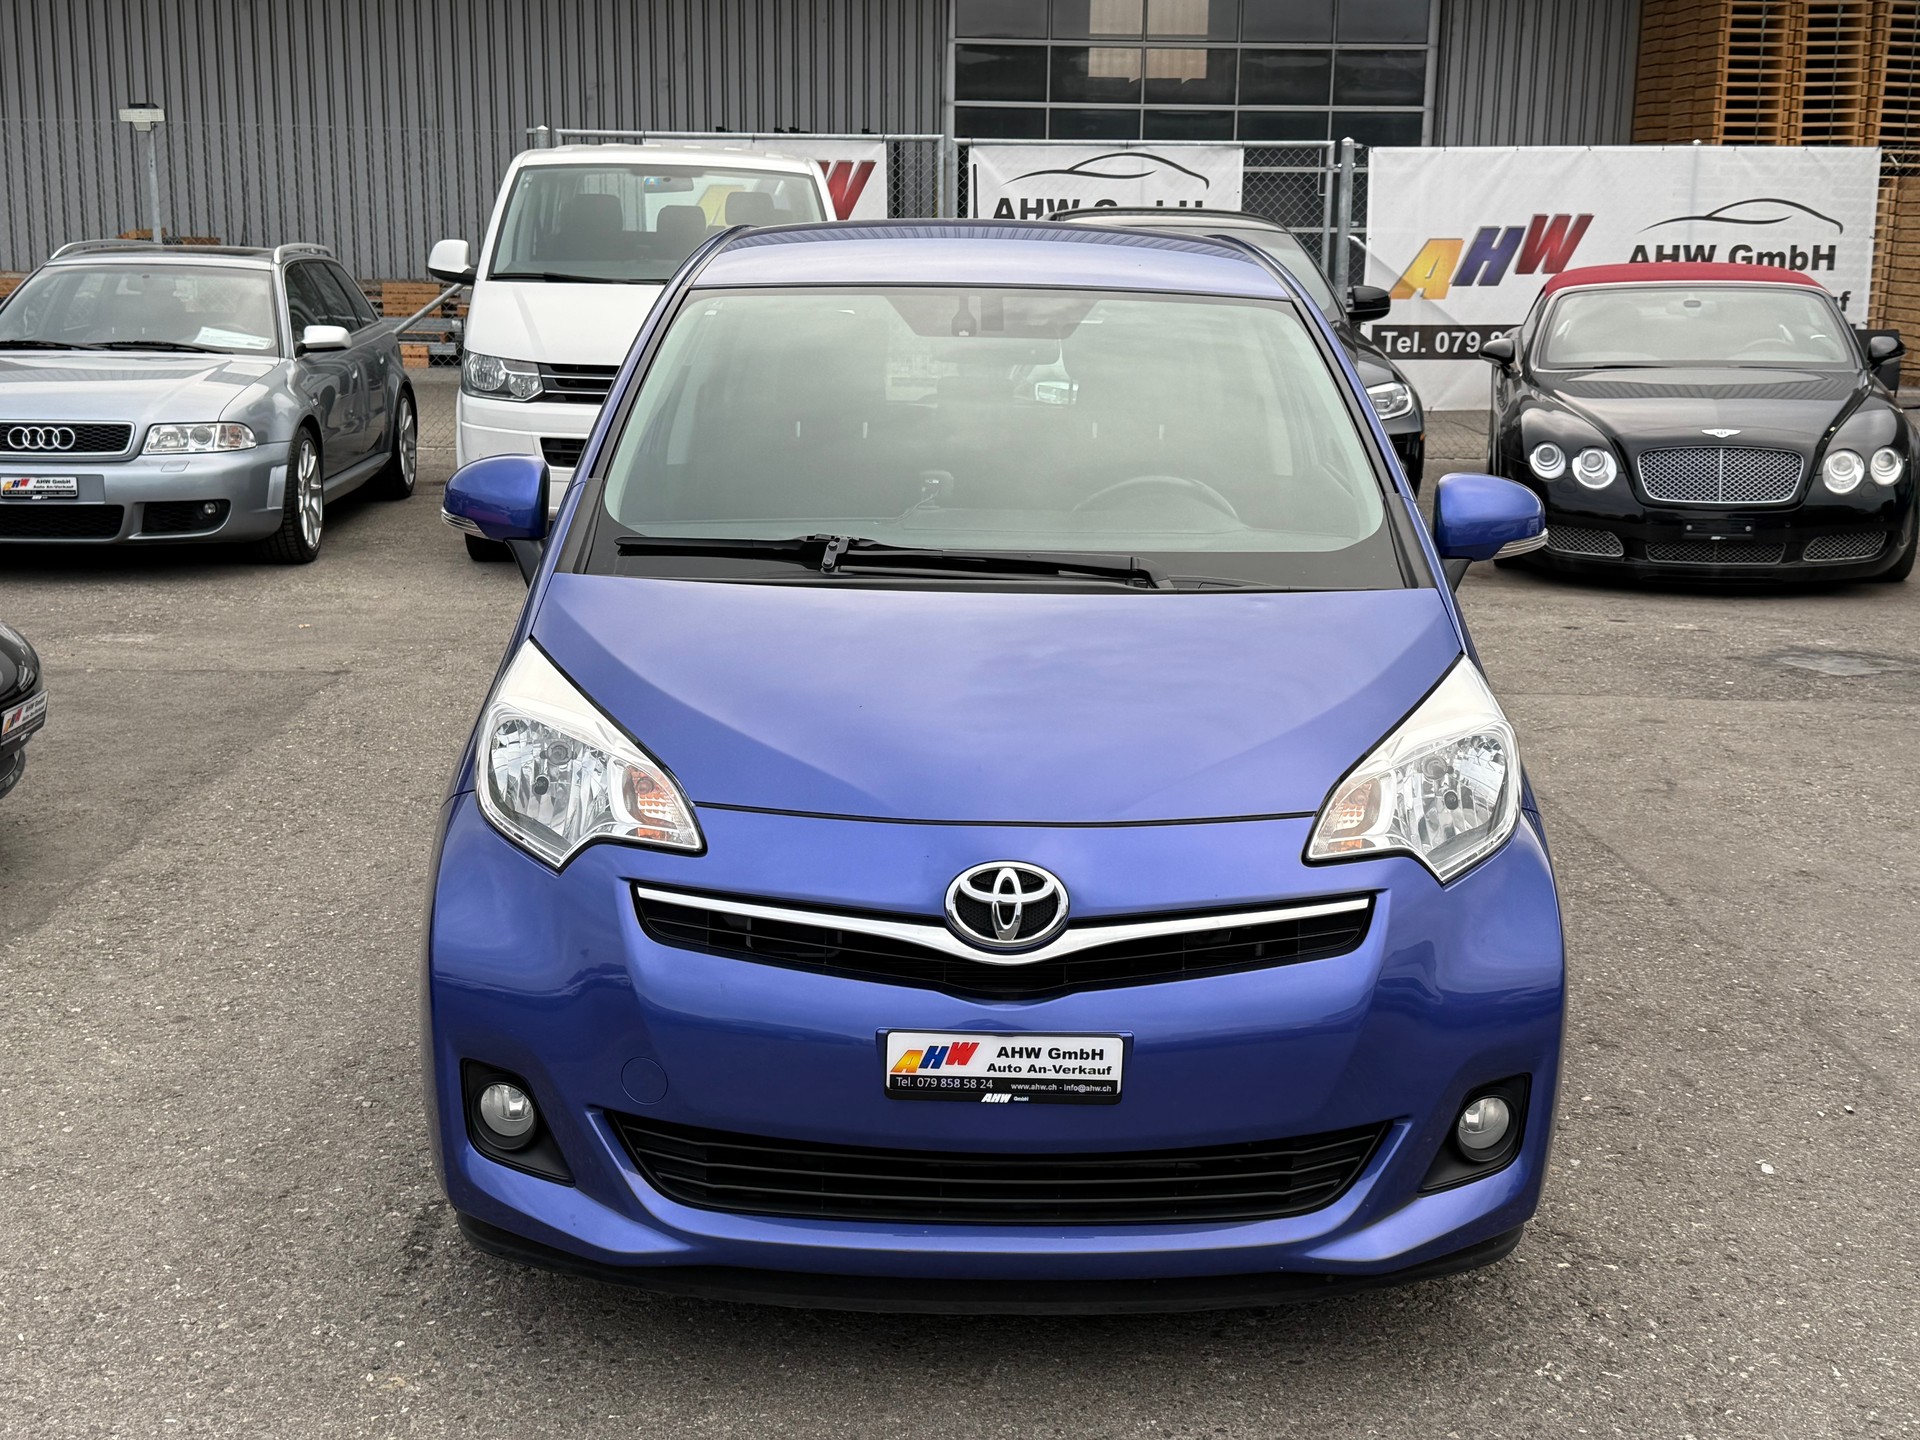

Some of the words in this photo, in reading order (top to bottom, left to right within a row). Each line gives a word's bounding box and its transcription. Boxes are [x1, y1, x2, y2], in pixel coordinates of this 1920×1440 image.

[1389, 213, 1594, 299] AHW
[1728, 244, 1837, 271] GmbH
[1380, 331, 1427, 353] Tel.
[1434, 331, 1481, 353] 079
[890, 1042, 979, 1073] AHW
[996, 1046, 1042, 1059] AHW
[1047, 1047, 1104, 1061] GmbH
[986, 1063, 1022, 1073] Auto
[1027, 1064, 1112, 1076] An-Verkauf
[895, 1076, 914, 1088] Tel.
[916, 1077, 938, 1088] 079
[940, 1078, 961, 1089] 858
[963, 1079, 977, 1089] 58
[980, 1079, 994, 1090] 24
[1010, 1083, 1058, 1091] www.ahw.ch
[980, 1093, 1012, 1104] AHW
